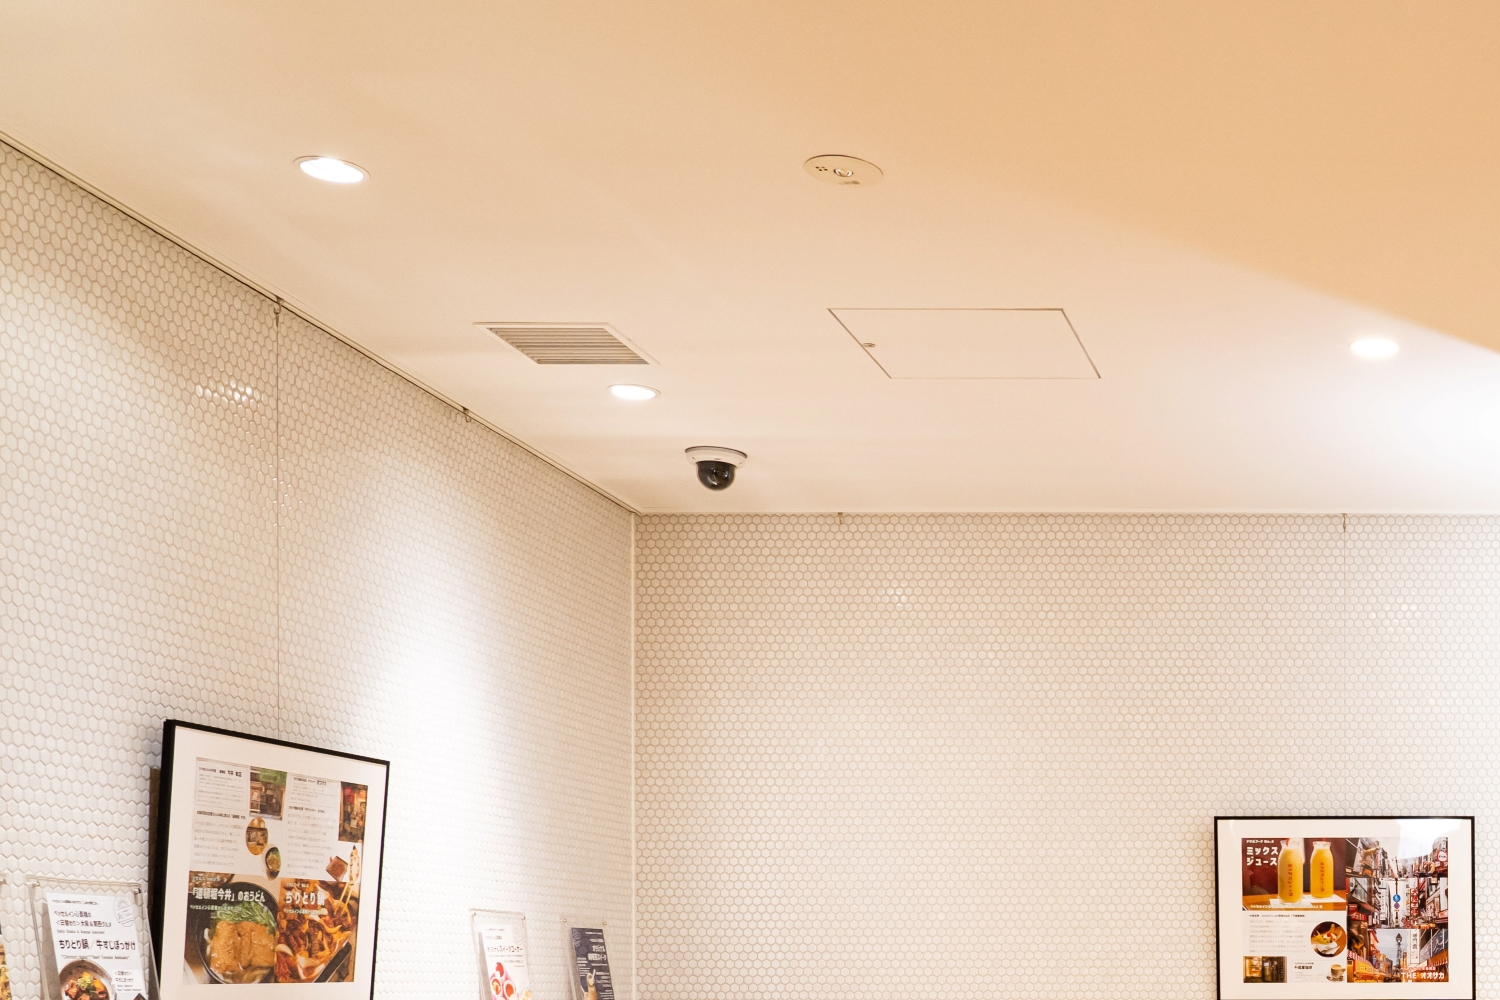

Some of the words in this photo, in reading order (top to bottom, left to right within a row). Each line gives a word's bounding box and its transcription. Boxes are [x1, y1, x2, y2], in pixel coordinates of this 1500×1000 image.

[1246, 846, 1279, 856] ミックス
[1246, 856, 1278, 866] ジュース
[285, 890, 326, 906] ちりとり鍋
[1421, 972, 1445, 980] オオサカ
